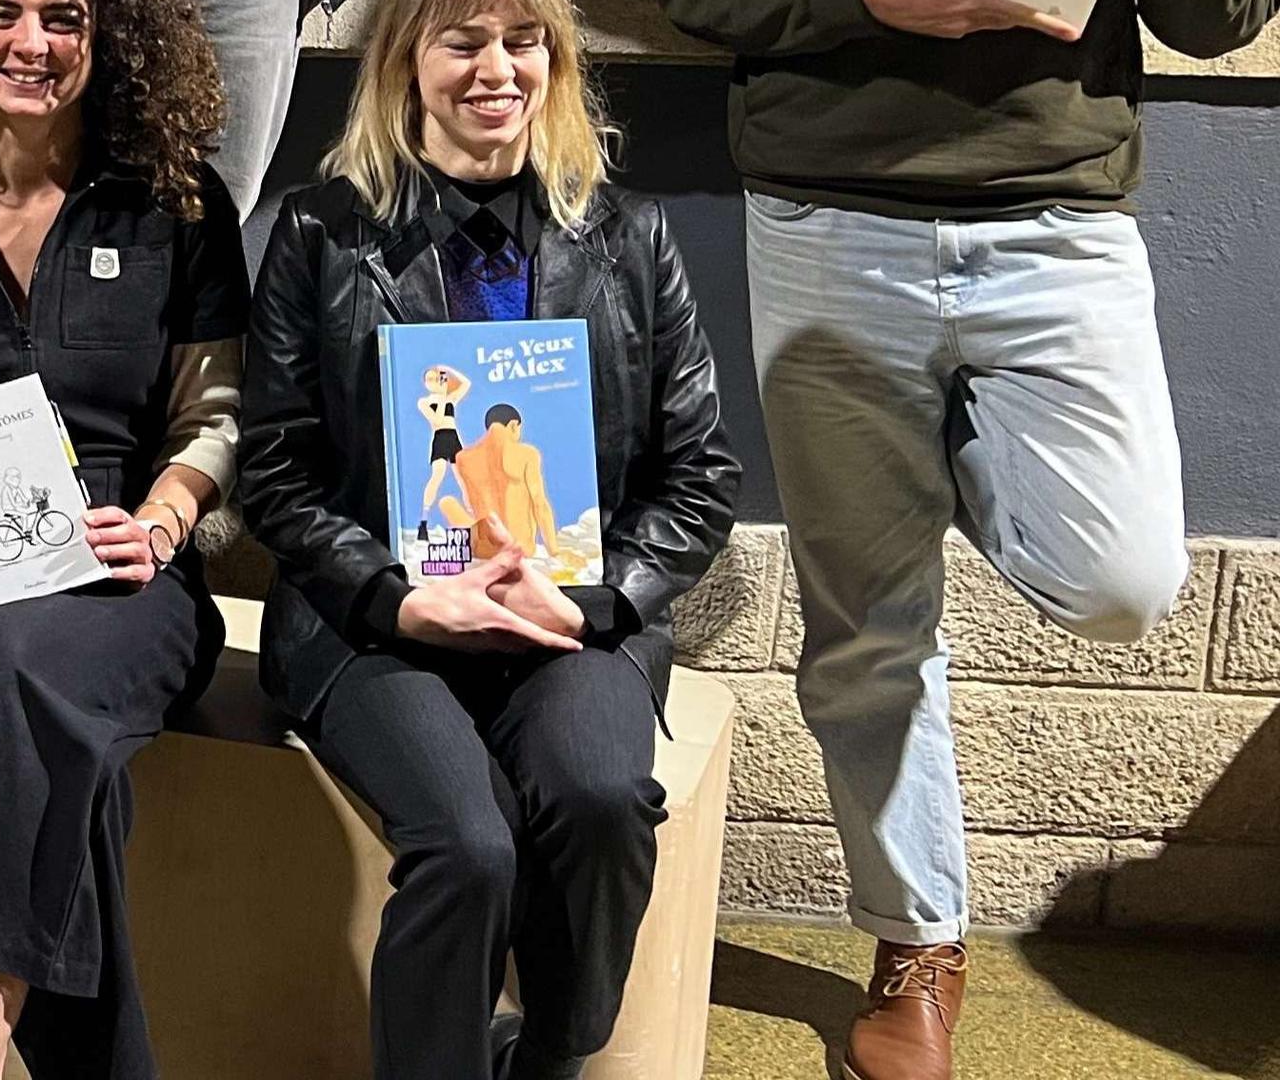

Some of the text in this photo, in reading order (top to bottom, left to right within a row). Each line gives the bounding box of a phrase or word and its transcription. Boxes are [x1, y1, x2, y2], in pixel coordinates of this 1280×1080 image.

[477, 337, 575, 364] Les Yeux
[488, 357, 566, 382] d'Alex
[447, 529, 469, 546] POP
[429, 545, 470, 561] WOMEN
